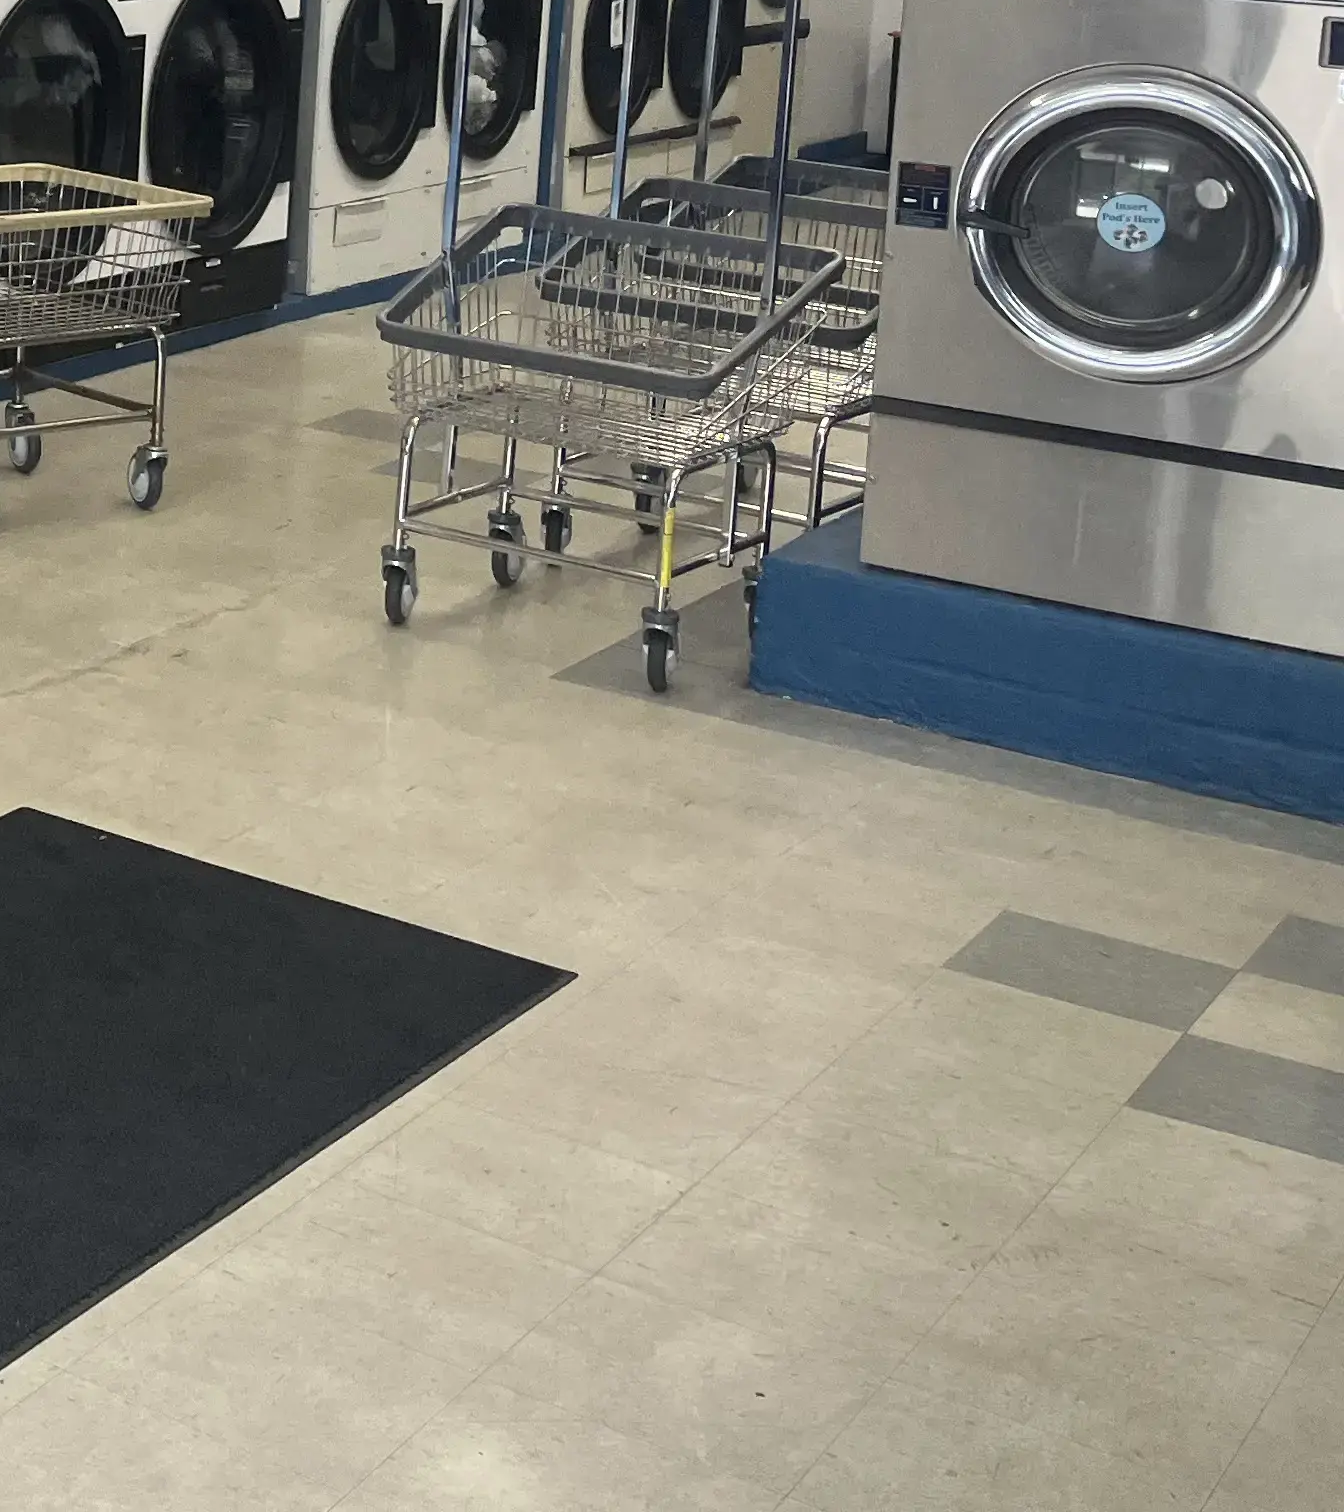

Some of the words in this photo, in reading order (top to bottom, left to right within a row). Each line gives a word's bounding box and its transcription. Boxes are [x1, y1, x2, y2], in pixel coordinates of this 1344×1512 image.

[1116, 202, 1148, 212] Insert
[1102, 212, 1131, 223] Pod's
[1133, 215, 1161, 224] Here
